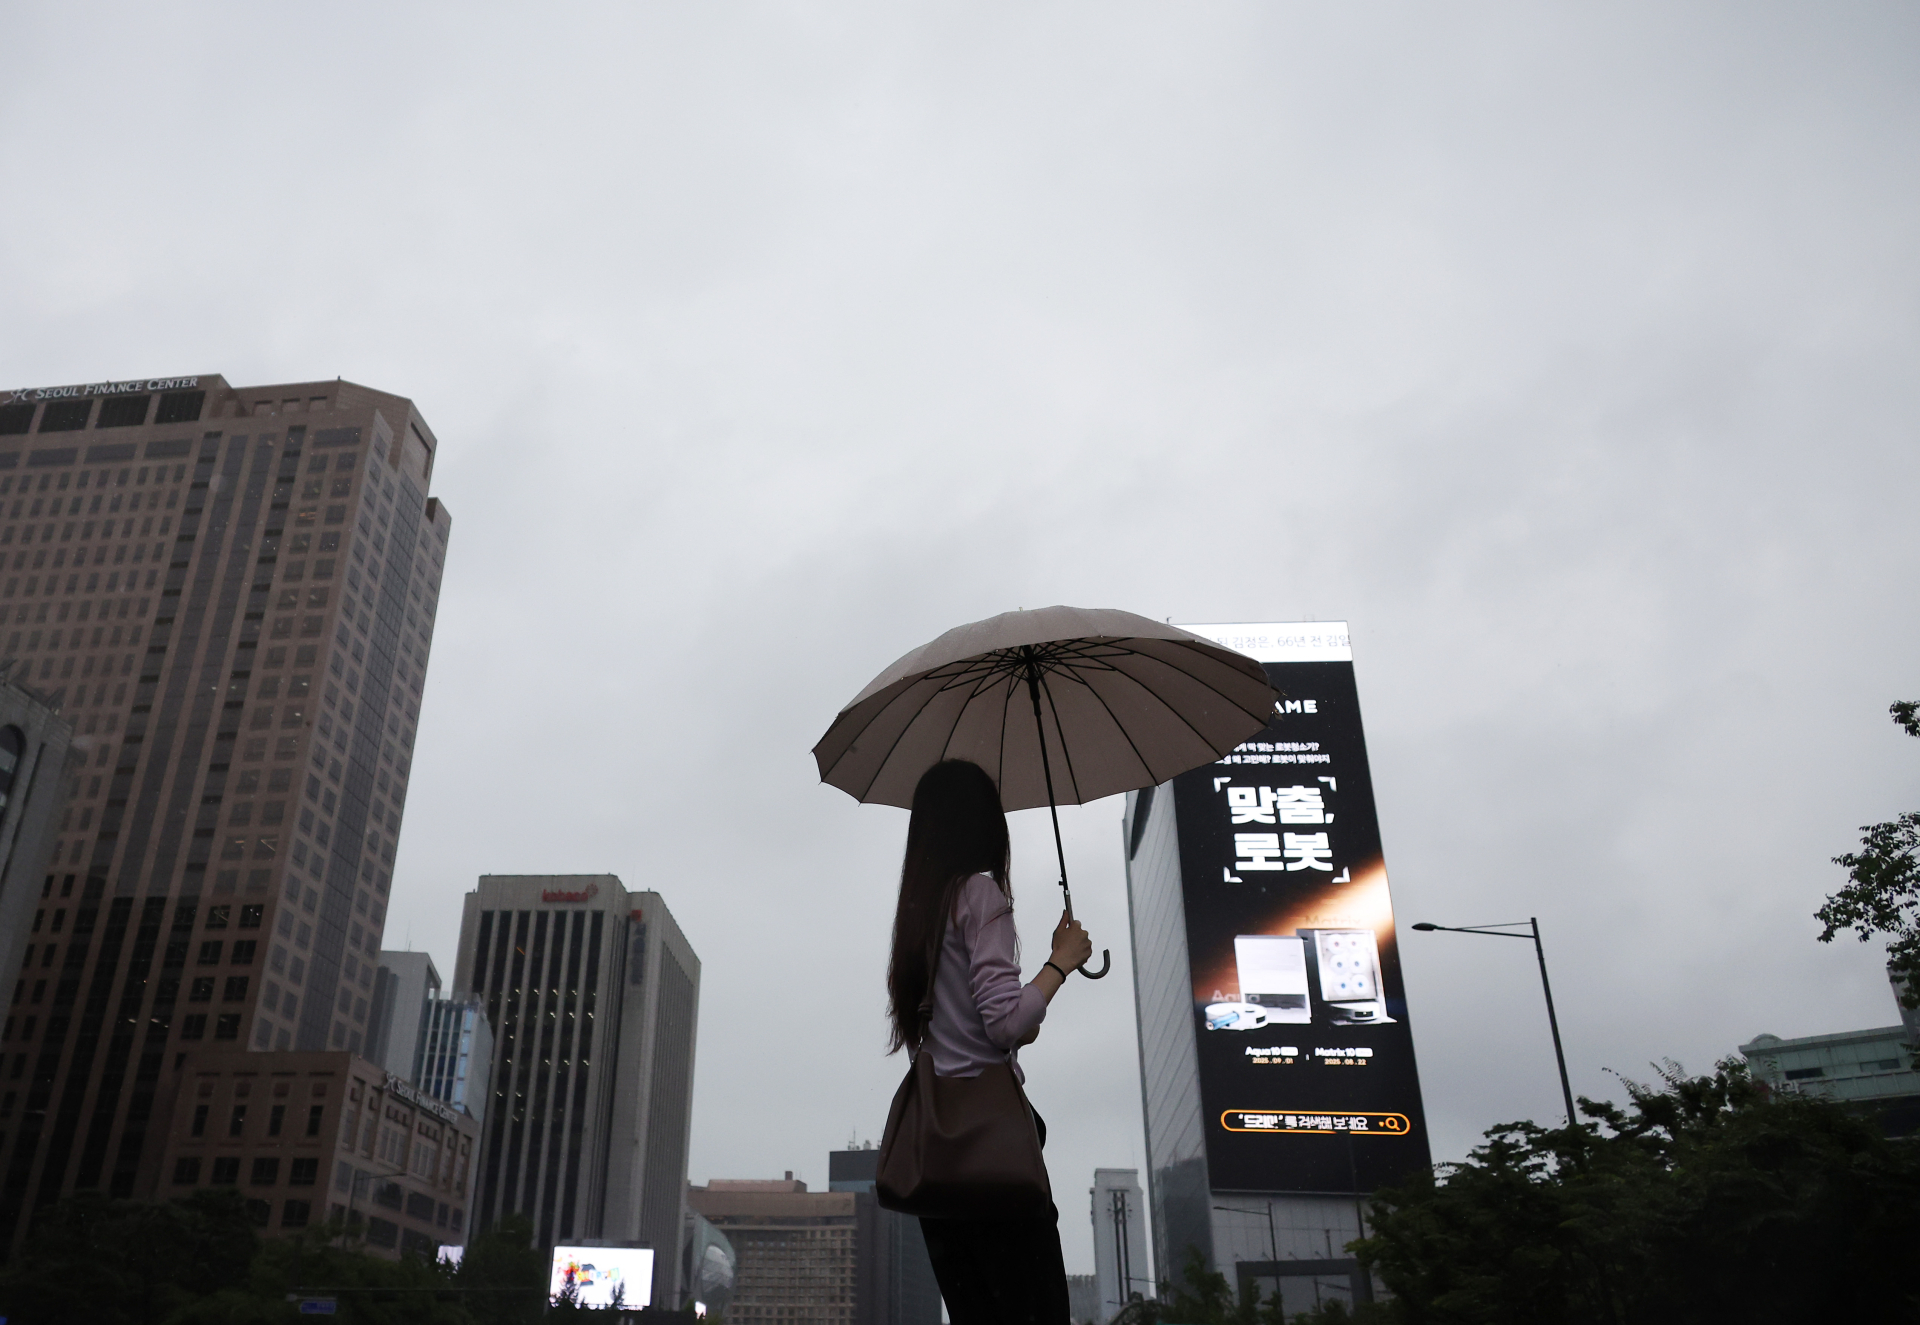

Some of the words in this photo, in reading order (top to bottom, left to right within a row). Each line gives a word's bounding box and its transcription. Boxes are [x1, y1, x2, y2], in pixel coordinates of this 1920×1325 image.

[35, 387, 79, 399] SEOUL
[84, 382, 143, 395] FINANCE
[147, 377, 198, 390] CENTER
[1277, 636, 1306, 648] 66년
[1310, 635, 1322, 647] 전
[1227, 785, 1335, 824] 맞춤,
[1234, 832, 1334, 872] 로봇
[1305, 915, 1361, 925] Matrix
[1298, 1115, 1333, 1130] 검색해
